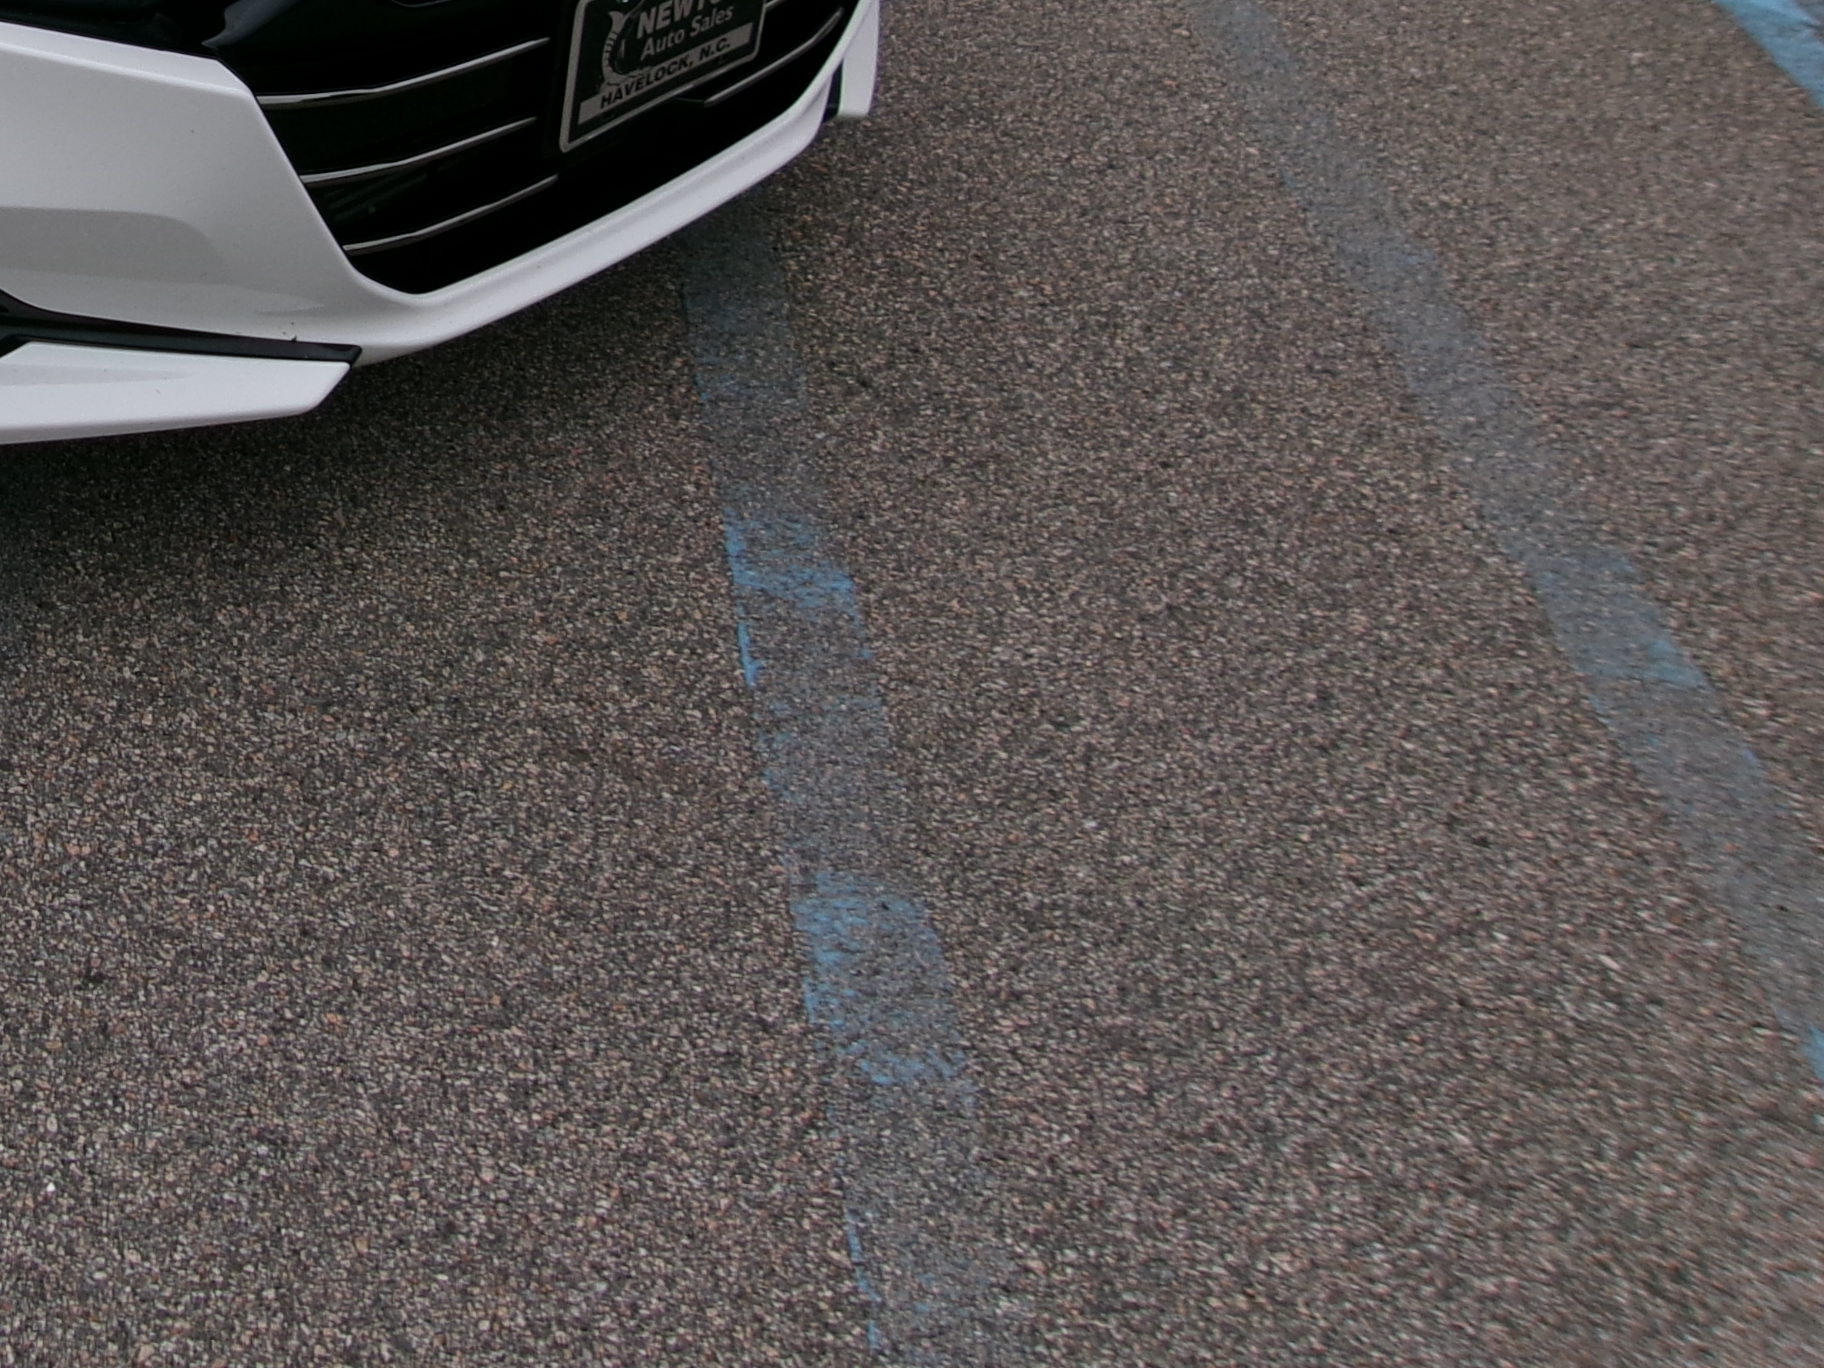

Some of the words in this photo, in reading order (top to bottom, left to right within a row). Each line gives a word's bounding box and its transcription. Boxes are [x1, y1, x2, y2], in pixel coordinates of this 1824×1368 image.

[640, 29, 685, 61] Auto
[690, 5, 734, 37] Sales
[600, 54, 694, 110] HAVELOCK,
[699, 36, 731, 61] N.C.
